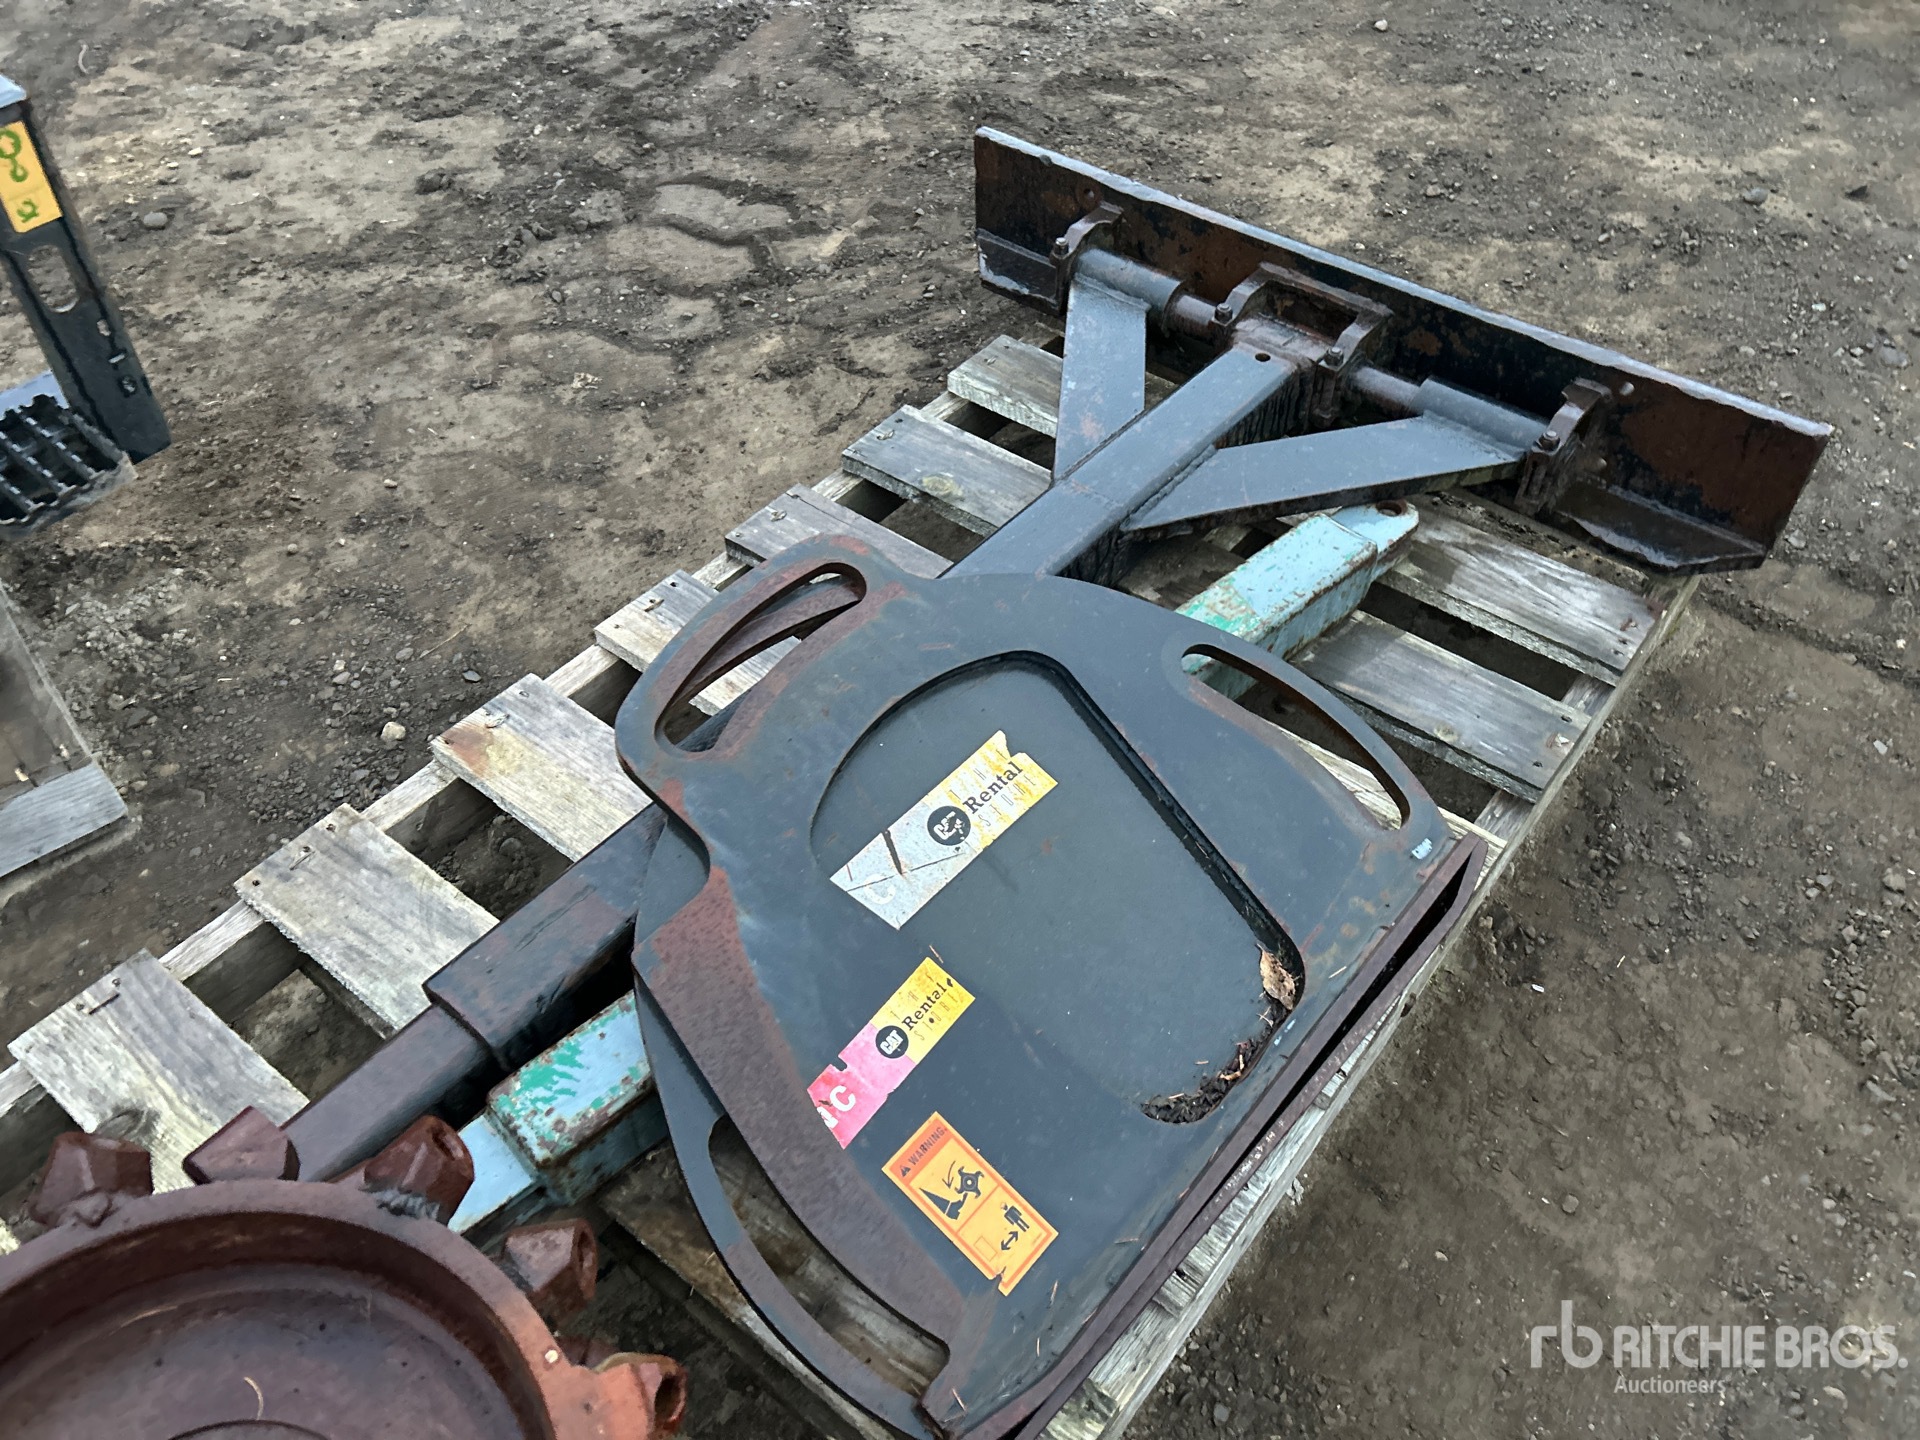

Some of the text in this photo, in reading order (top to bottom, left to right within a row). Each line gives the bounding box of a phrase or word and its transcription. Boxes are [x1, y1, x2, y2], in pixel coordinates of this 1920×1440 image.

[962, 760, 1024, 815] Rental
[879, 982, 947, 1055] CAT Rental
